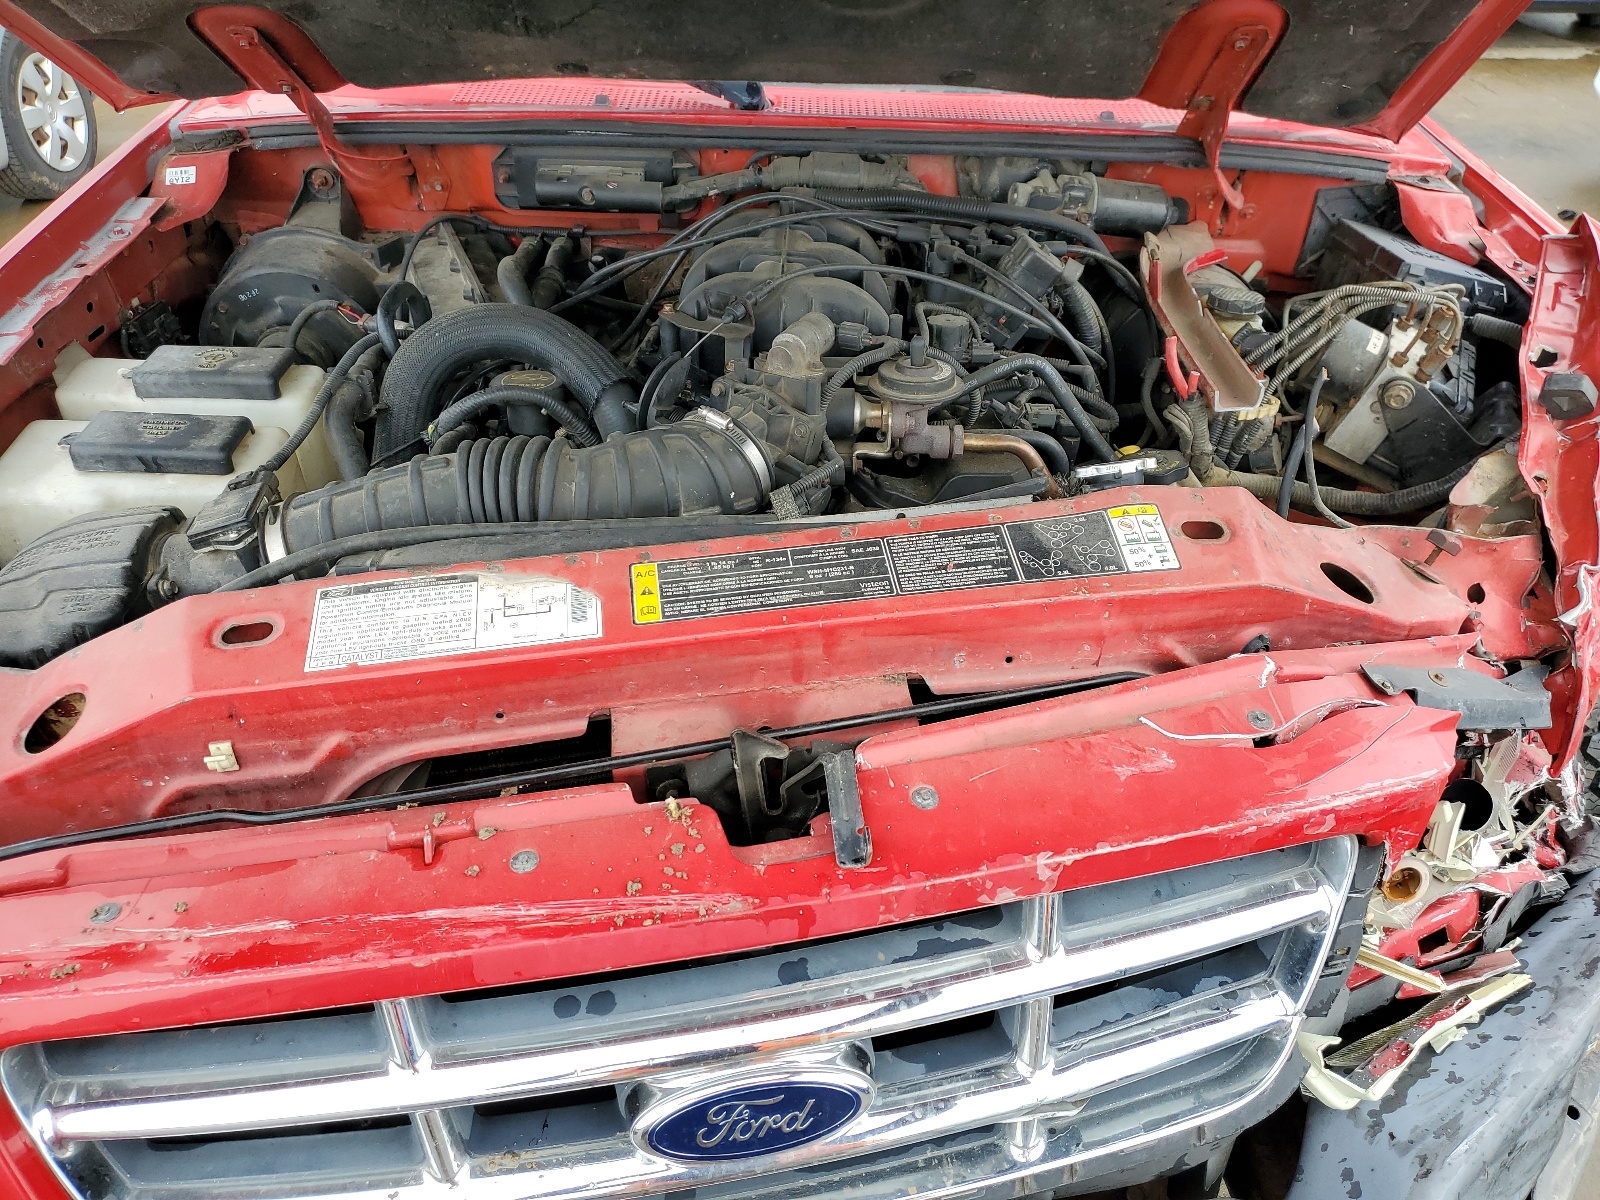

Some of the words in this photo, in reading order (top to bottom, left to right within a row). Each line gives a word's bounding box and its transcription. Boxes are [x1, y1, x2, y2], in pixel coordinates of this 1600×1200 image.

[636, 569, 656, 579] A/C
[341, 652, 380, 664] CATALYST
[697, 1094, 816, 1148] Ford
